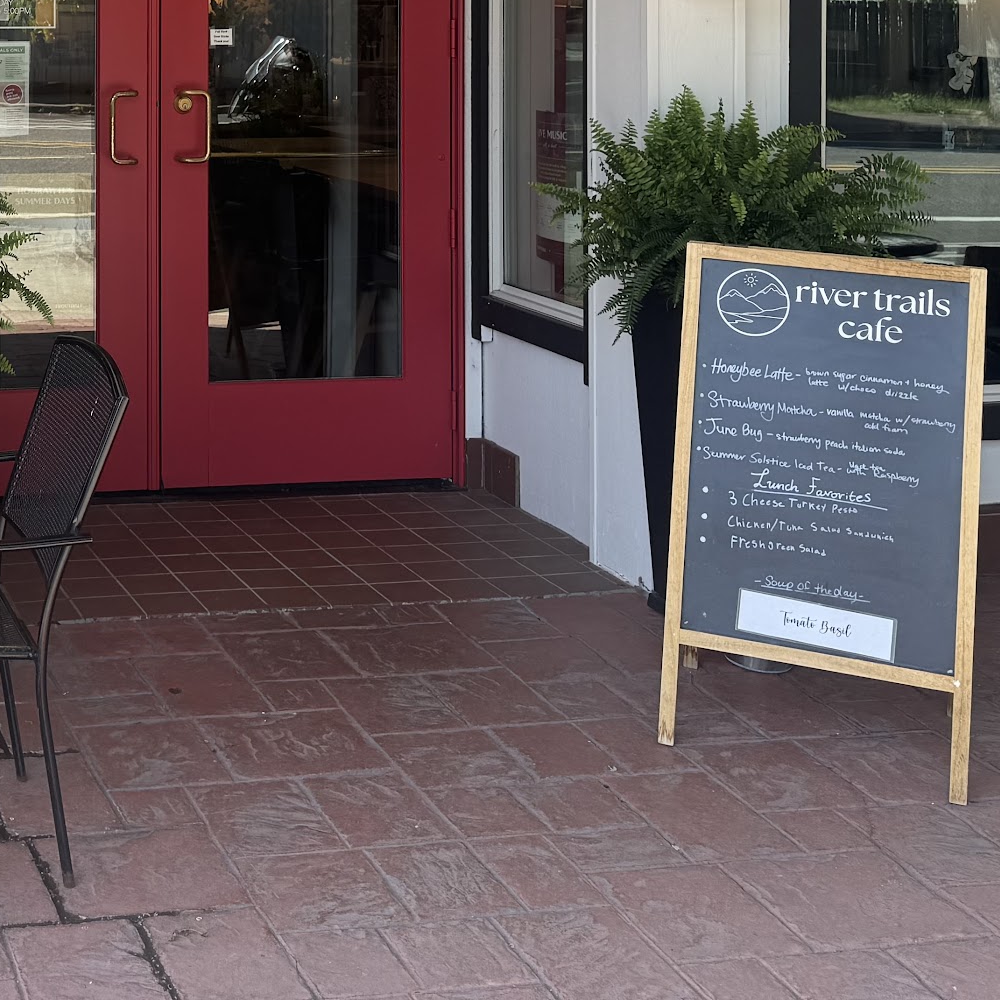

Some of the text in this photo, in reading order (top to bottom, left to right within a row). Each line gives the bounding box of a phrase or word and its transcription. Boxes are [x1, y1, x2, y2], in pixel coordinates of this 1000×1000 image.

[546, 129, 568, 141] MUSIC
[15, 196, 76, 205] SUMMER DAYS
[795, 281, 951, 317] river trails
[838, 316, 903, 344] cafe
[711, 358, 762, 382] Honeybee
[764, 364, 795, 382] Latte
[805, 367, 830, 377] brown
[833, 370, 857, 382] sugar
[860, 374, 903, 386] cinnamon
[914, 378, 950, 394] honey
[808, 377, 829, 387] latte
[885, 388, 919, 401] drizzle
[707, 390, 775, 421] Strawberry
[777, 402, 818, 417] Matcha
[826, 408, 854, 418] vanilla
[860, 412, 891, 423] matcha
[703, 417, 738, 437] June
[742, 423, 763, 442] Bug
[775, 432, 821, 449] strawberry
[825, 439, 848, 450] peach
[883, 447, 906, 456] soda
[703, 446, 746, 460] Summer
[749, 452, 791, 468] Solstice
[816, 461, 836, 474] Tea
[750, 468, 872, 503] Lunch Favorites
[728, 491, 858, 514] 3 Cheese Turkey Pesto
[810, 522, 841, 534] Salad
[799, 543, 827, 557] Salad
[764, 575, 794, 590] Soup
[796, 580, 811, 591] of
[780, 610, 852, 638] Tomato Basil
